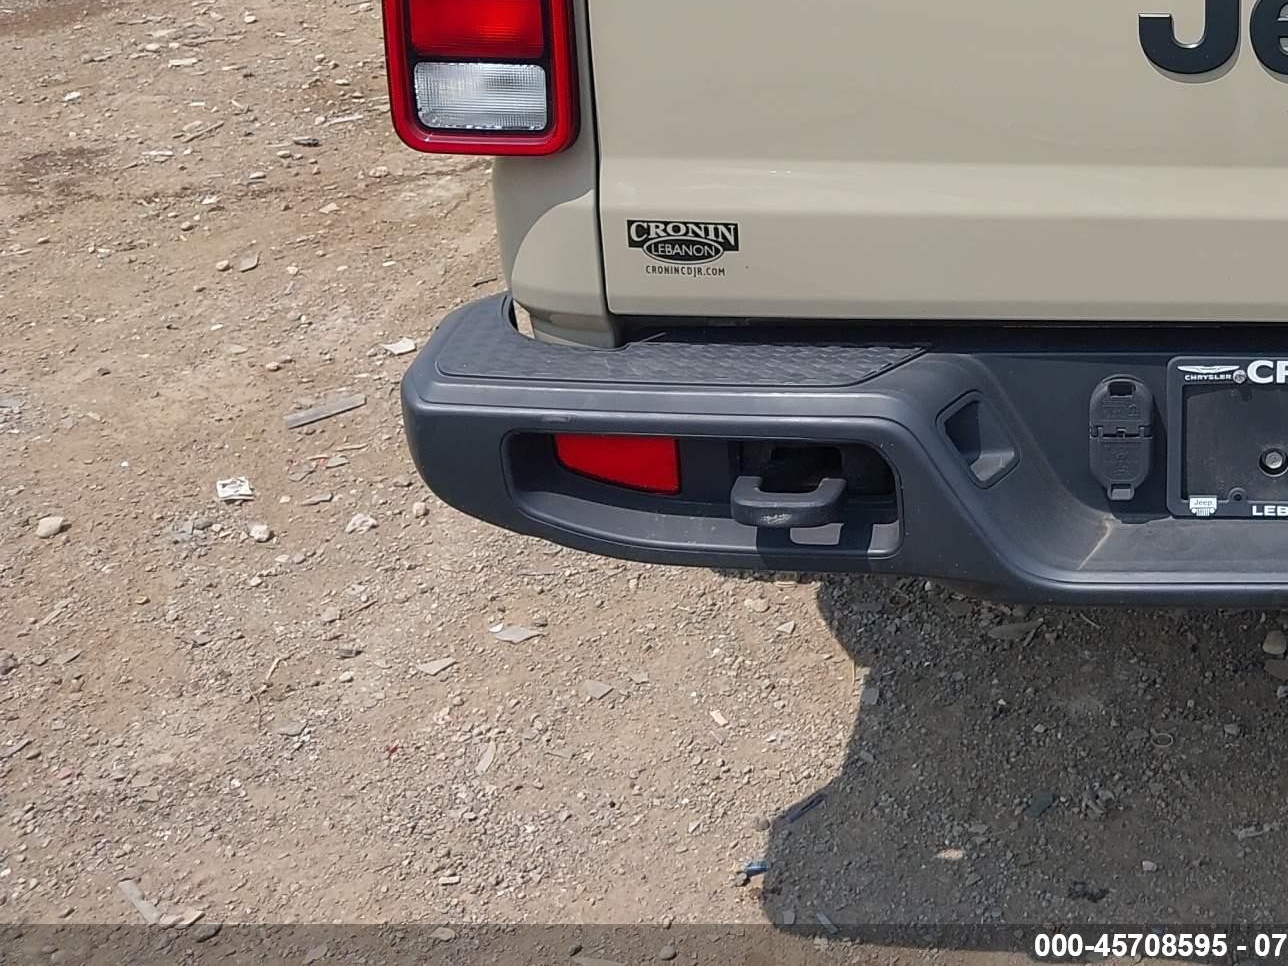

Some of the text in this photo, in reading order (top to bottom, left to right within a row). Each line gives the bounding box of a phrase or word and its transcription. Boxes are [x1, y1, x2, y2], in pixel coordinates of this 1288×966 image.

[630, 221, 736, 246] CRONIN
[651, 243, 716, 256] LEBANON
[645, 265, 726, 278] CRONINCDJR.COM
